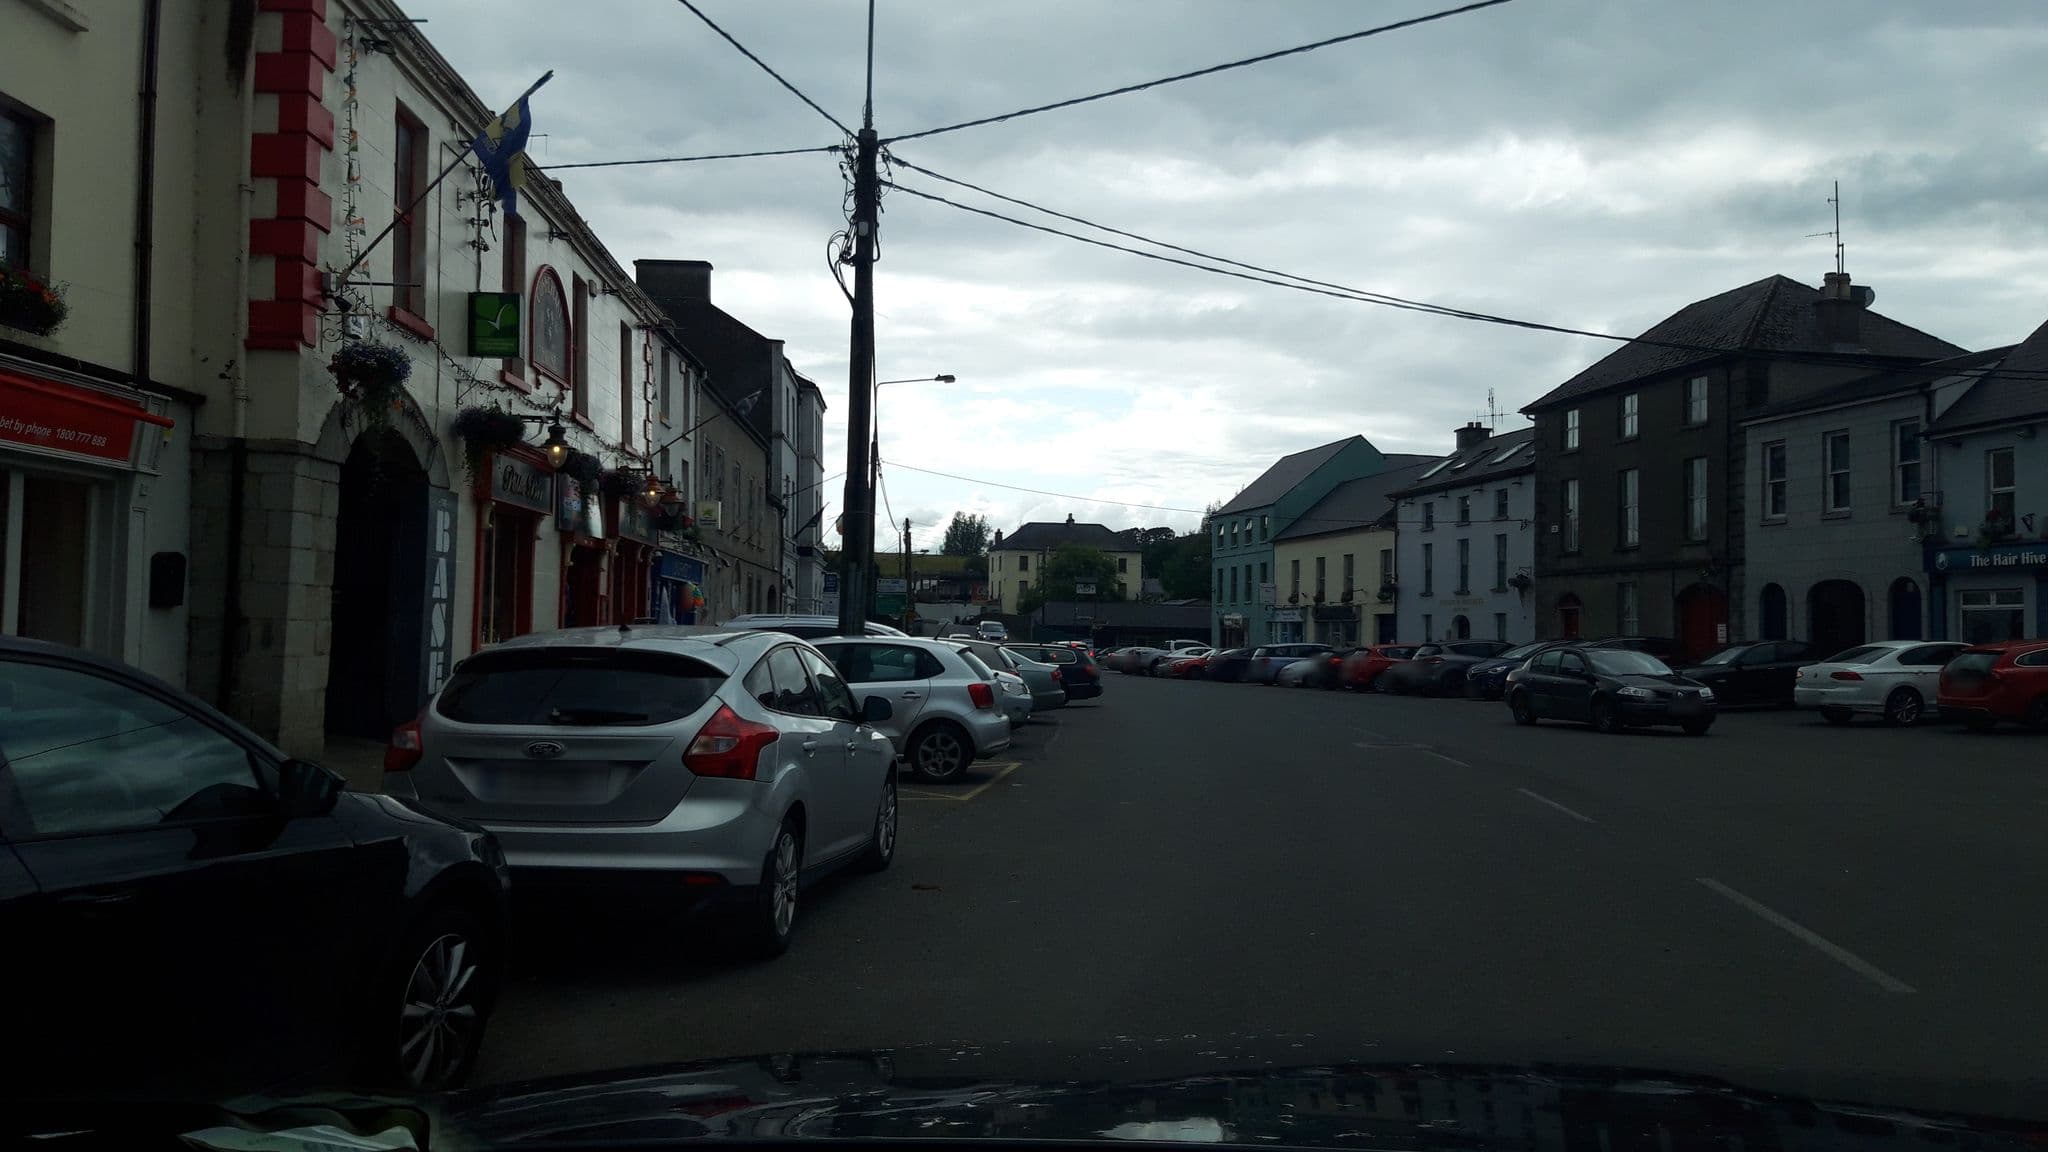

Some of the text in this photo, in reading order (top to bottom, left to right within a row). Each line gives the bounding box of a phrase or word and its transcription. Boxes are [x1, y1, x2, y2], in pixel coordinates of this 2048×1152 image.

[0, 416, 14, 429] bet
[14, 419, 25, 434] by
[25, 421, 52, 436] phone
[56, 428, 76, 441] 1800
[76, 432, 91, 443] 777
[1970, 551, 2047, 567] The Hair Hive
